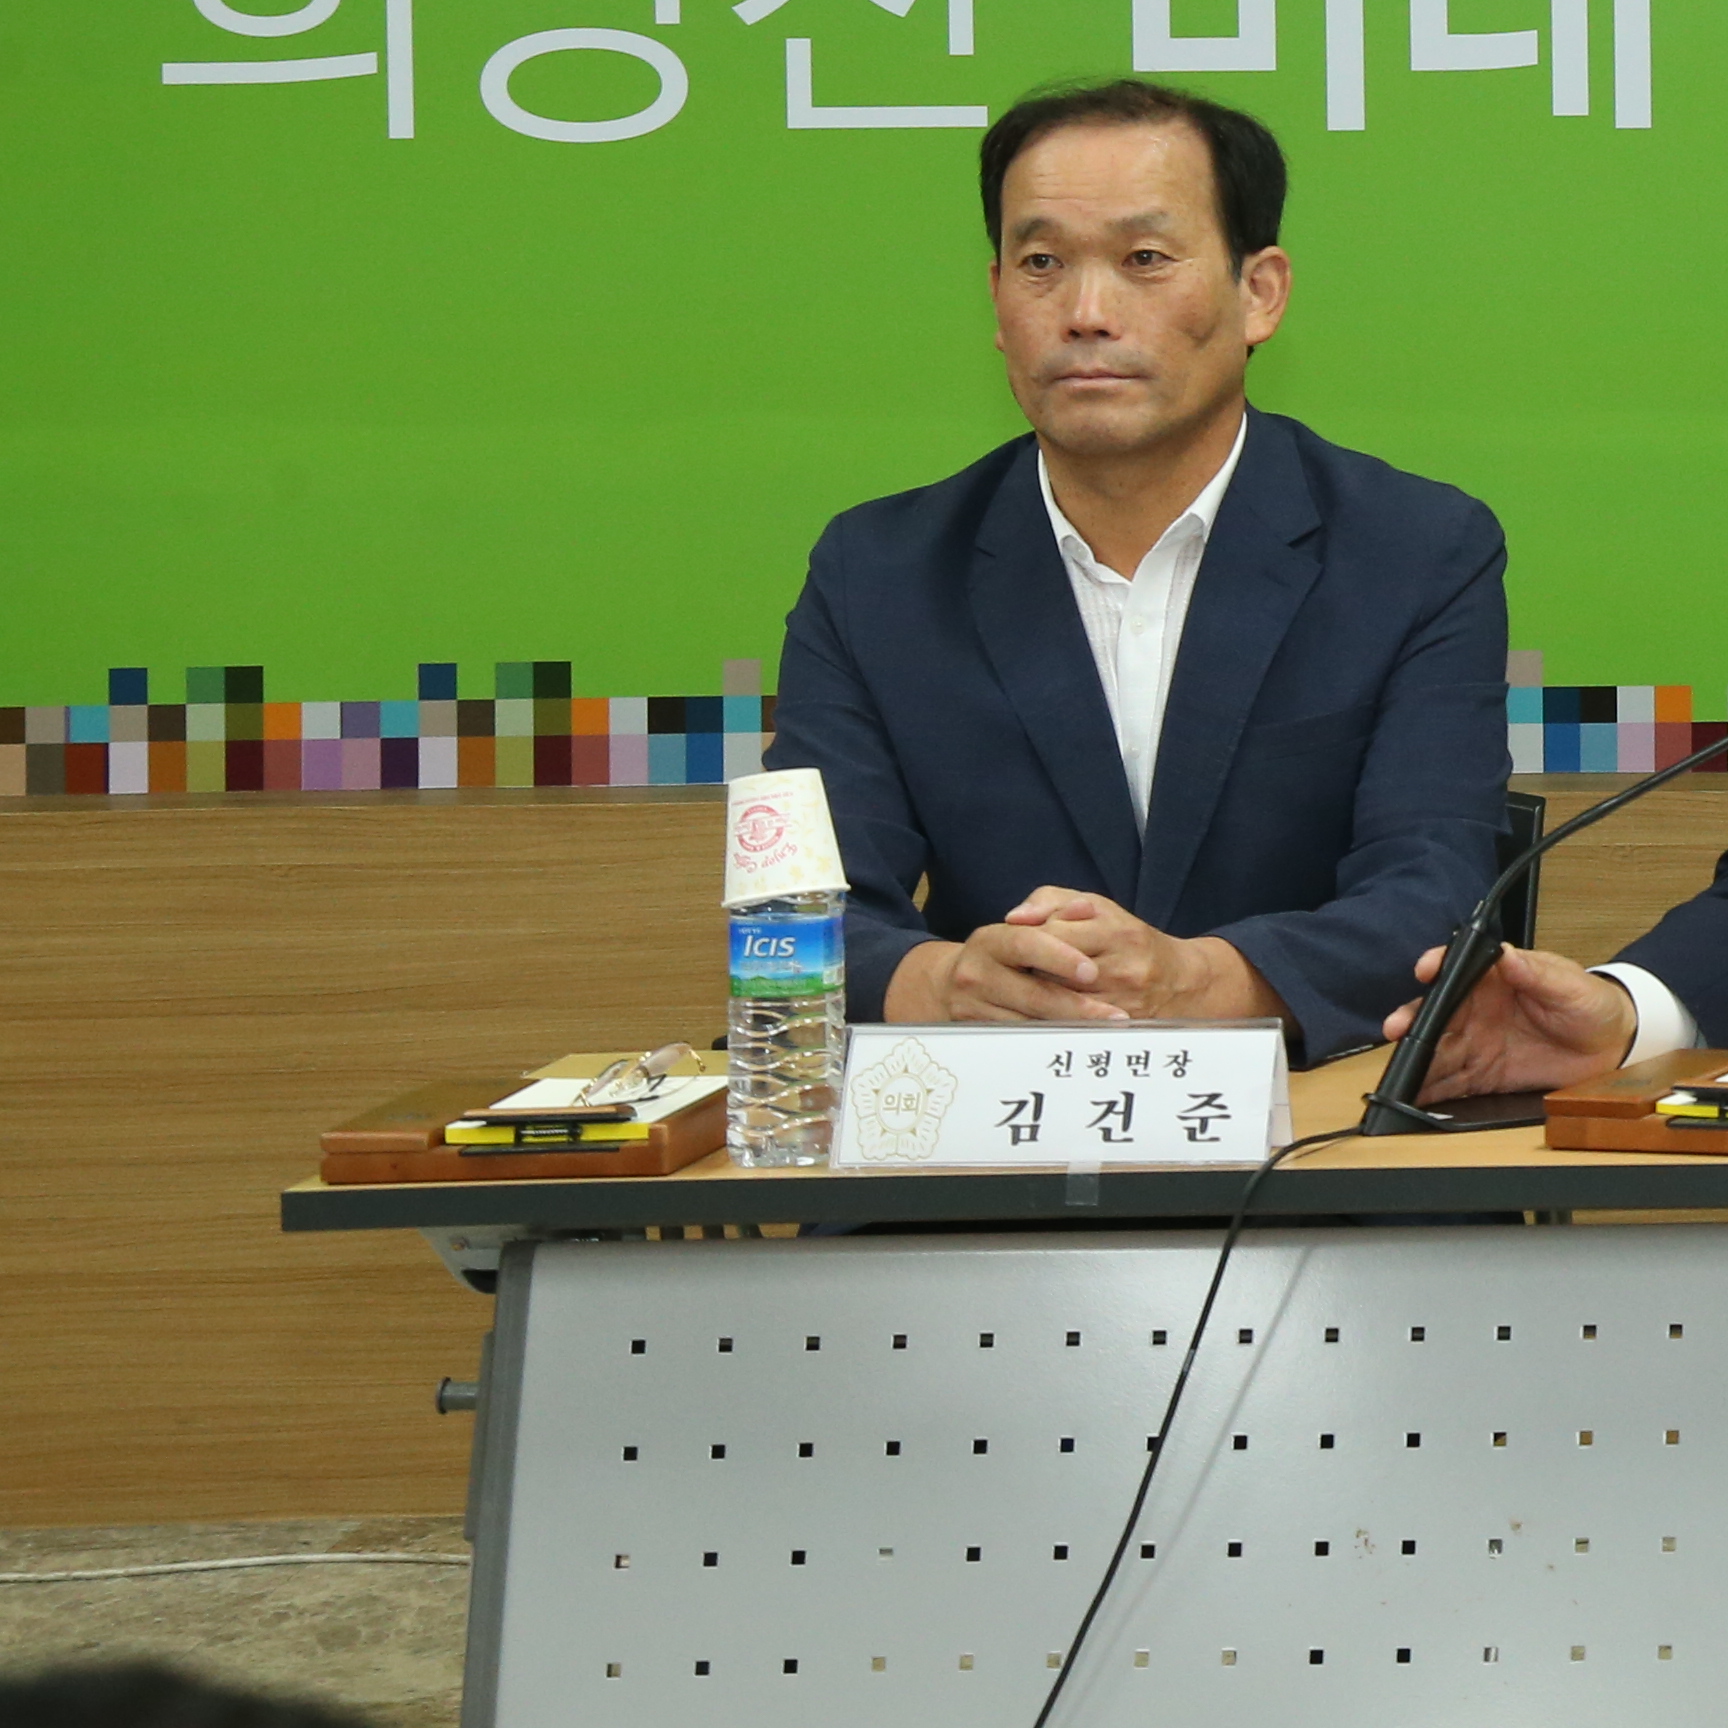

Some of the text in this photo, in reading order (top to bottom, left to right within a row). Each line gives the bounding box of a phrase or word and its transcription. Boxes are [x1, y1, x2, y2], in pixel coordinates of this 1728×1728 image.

[743, 935, 796, 958] ICIS
[1046, 1050, 1193, 1079] 신평면장
[881, 1091, 921, 1117] 의회
[994, 1090, 1232, 1147] 김건준
